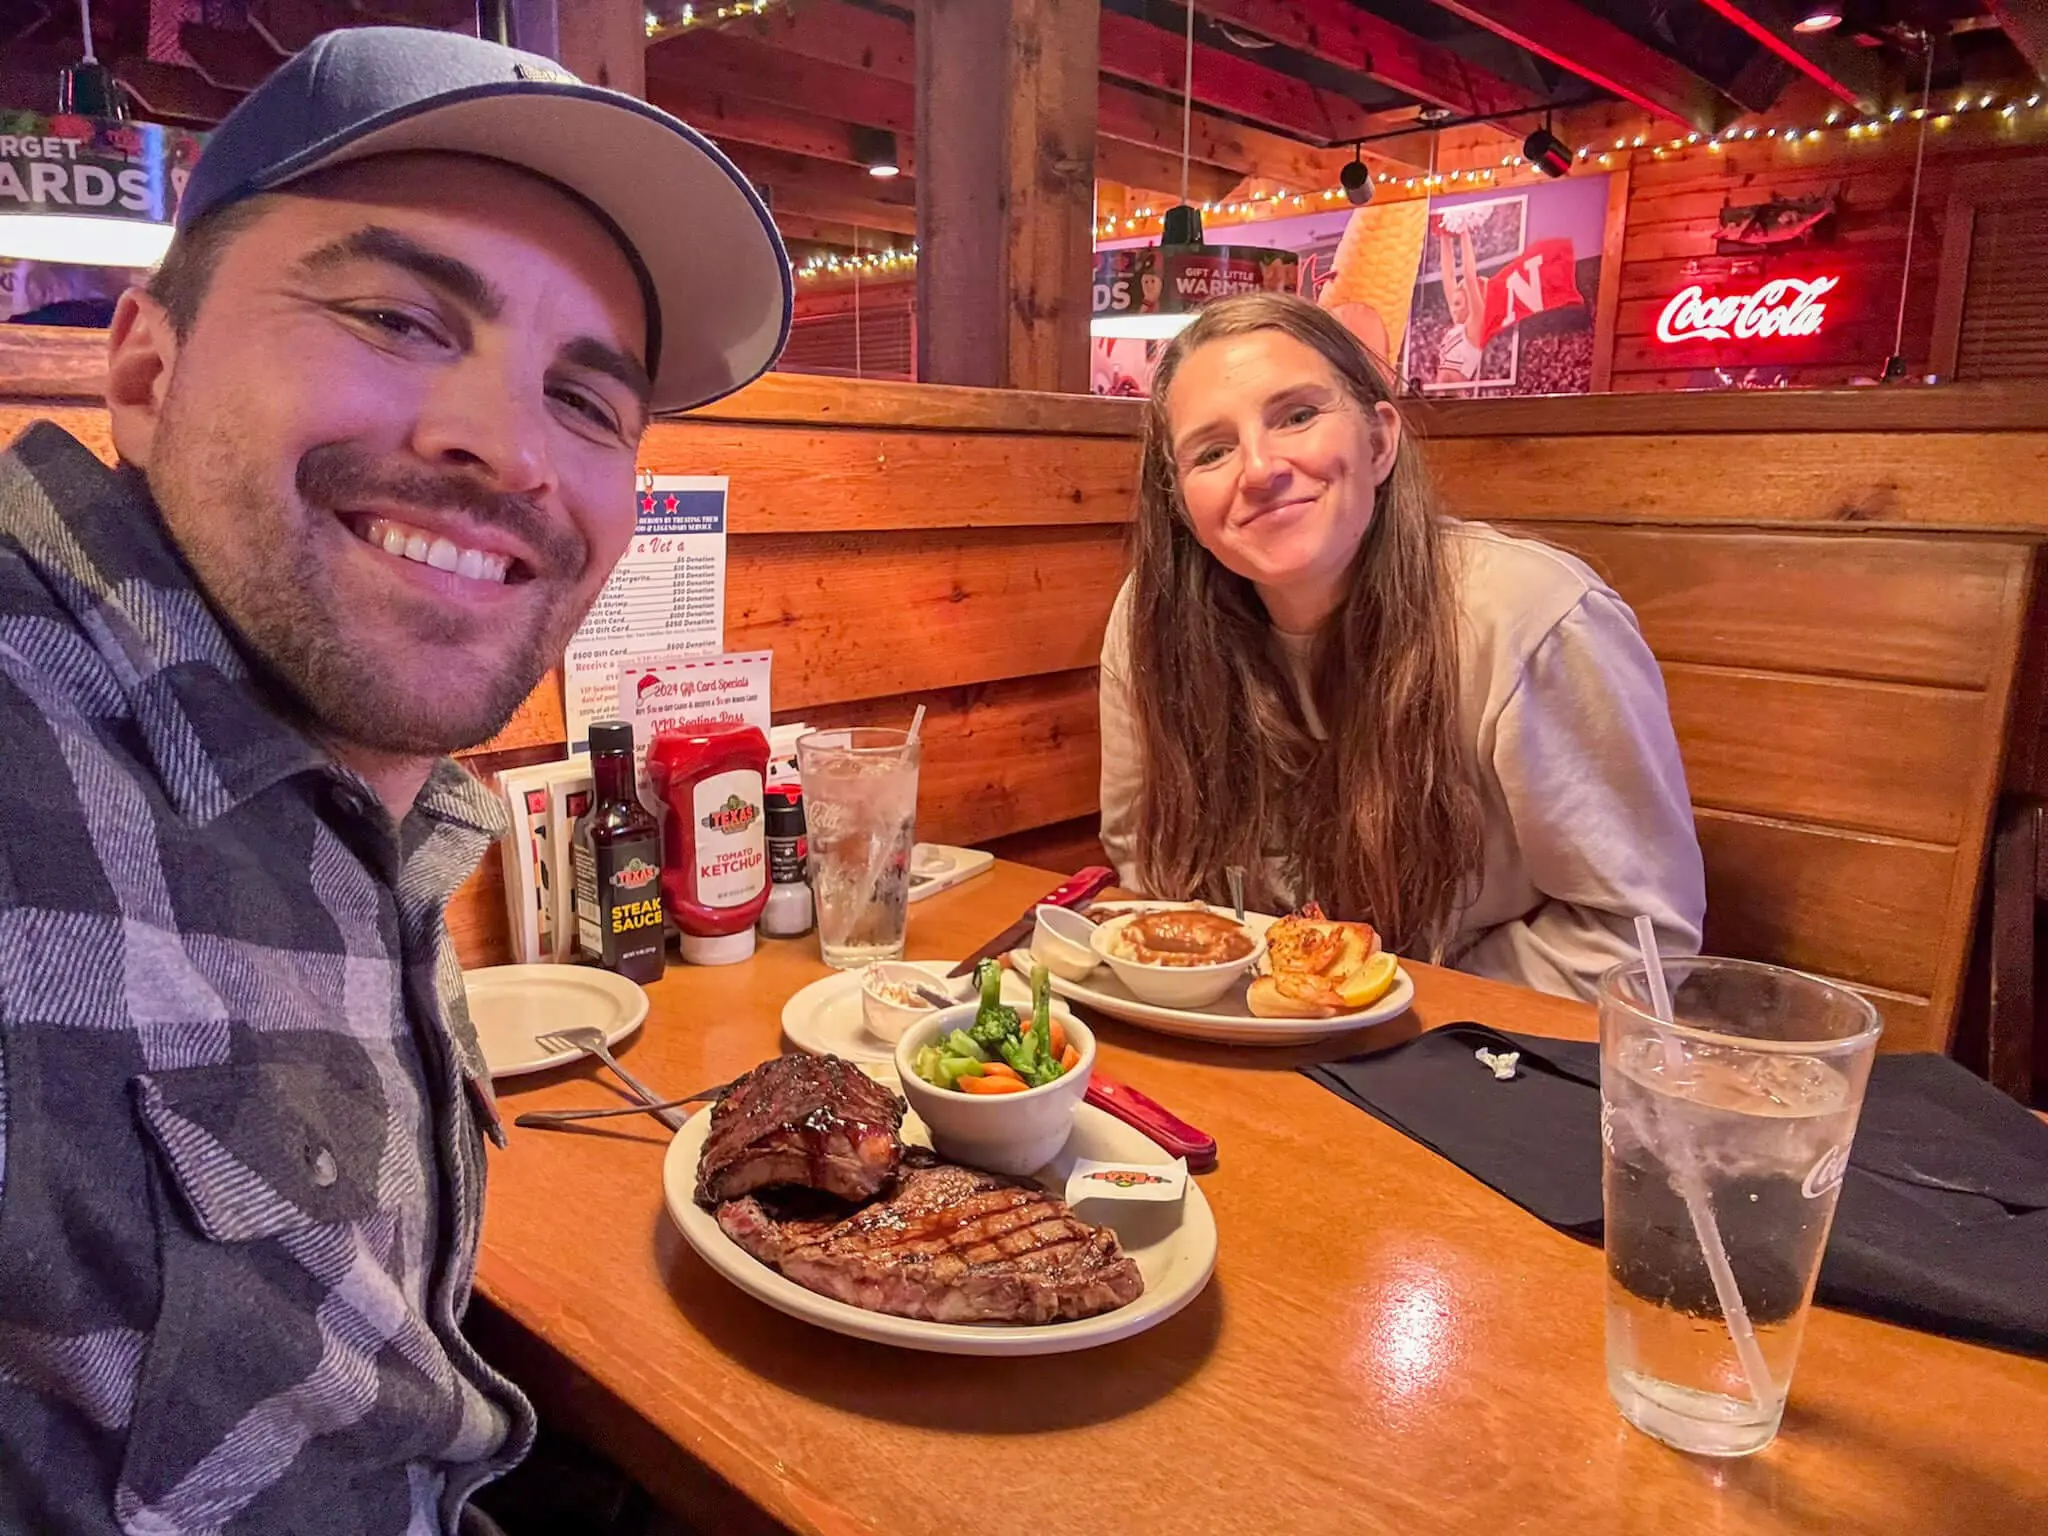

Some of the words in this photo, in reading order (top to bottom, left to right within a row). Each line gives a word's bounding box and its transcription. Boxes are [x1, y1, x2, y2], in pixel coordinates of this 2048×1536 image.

[0, 135, 81, 160] RGET
[0, 161, 151, 211] ARDS
[1185, 267, 1209, 277] GIFT
[1212, 269, 1220, 277] A
[1223, 270, 1254, 281] LITTLE
[1093, 281, 1131, 312] DS
[1502, 255, 1546, 328] N
[637, 543, 645, 553] a
[650, 537, 673, 553] Vet
[611, 624, 630, 632] Card
[609, 648, 628, 656] Card
[654, 683, 678, 697] 2024
[696, 679, 717, 693] Card
[718, 675, 749, 692] Specials
[711, 806, 753, 828] TEXAS
[701, 853, 762, 878] KETCHUP
[716, 847, 753, 863] TOMATO
[619, 867, 655, 885] TEXAS
[612, 897, 661, 919] STEAK
[612, 911, 662, 933] SAUCE
